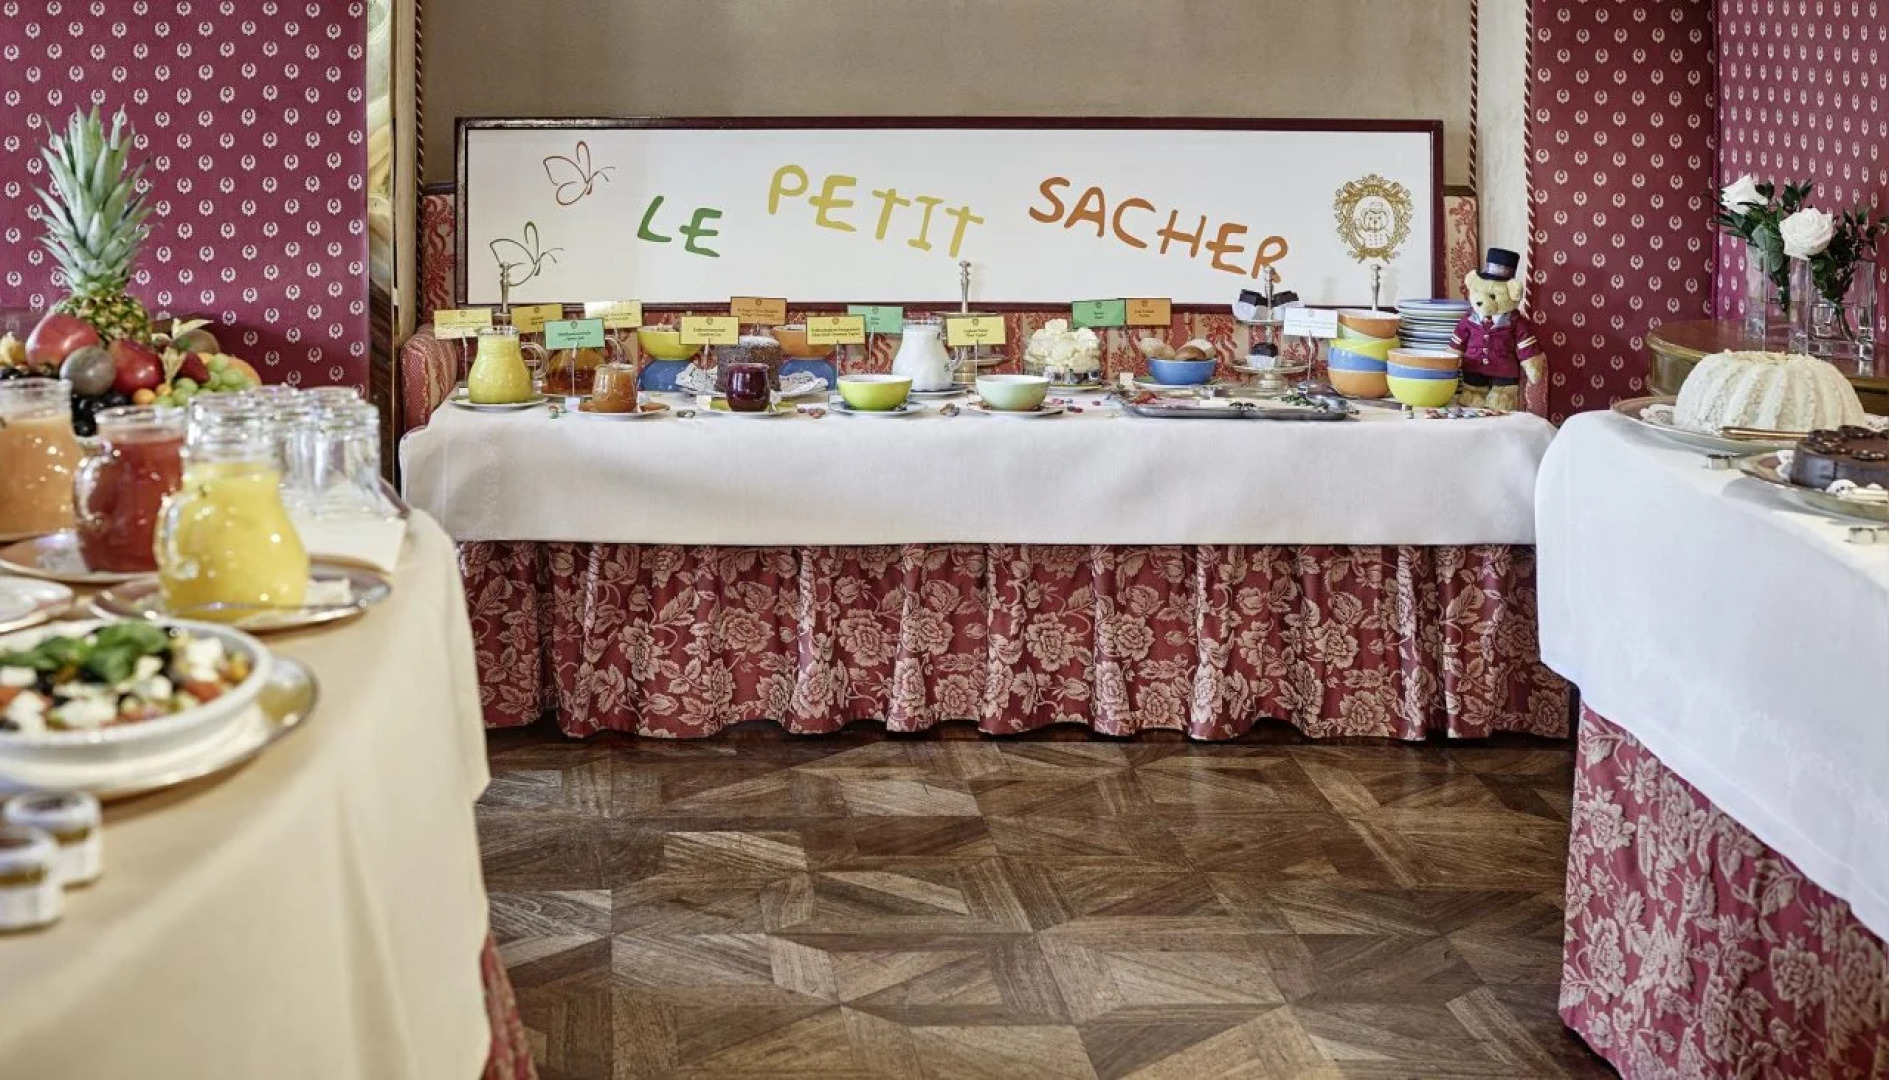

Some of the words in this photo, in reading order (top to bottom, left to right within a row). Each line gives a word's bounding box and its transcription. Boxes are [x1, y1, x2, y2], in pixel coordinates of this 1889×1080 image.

[637, 196, 722, 257] LE
[768, 164, 984, 258] PETIT
[1028, 176, 1288, 283] SACHER
